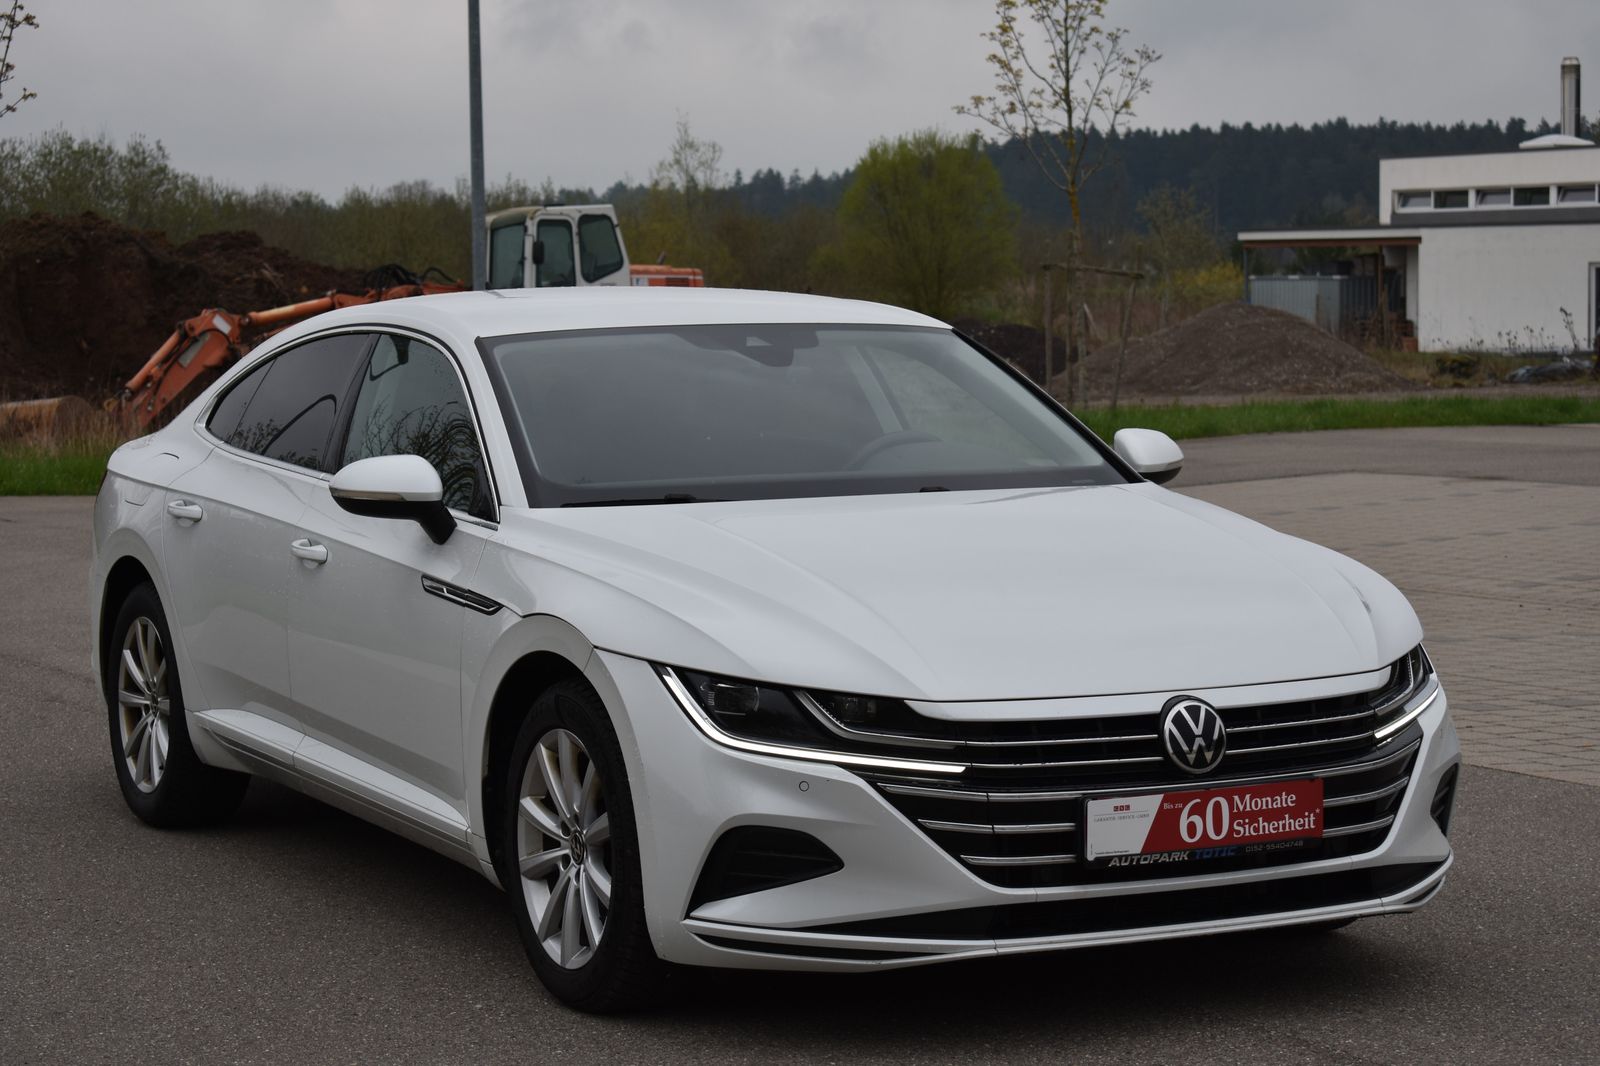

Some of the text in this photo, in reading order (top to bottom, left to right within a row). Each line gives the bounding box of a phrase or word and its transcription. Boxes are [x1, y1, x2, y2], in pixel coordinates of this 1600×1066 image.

[1166, 702, 1222, 768] VW
[1163, 802, 1173, 810] Bis
[1232, 791, 1296, 813] Monate
[1179, 796, 1230, 843] 60
[1108, 851, 1190, 867] AUTOPARK
